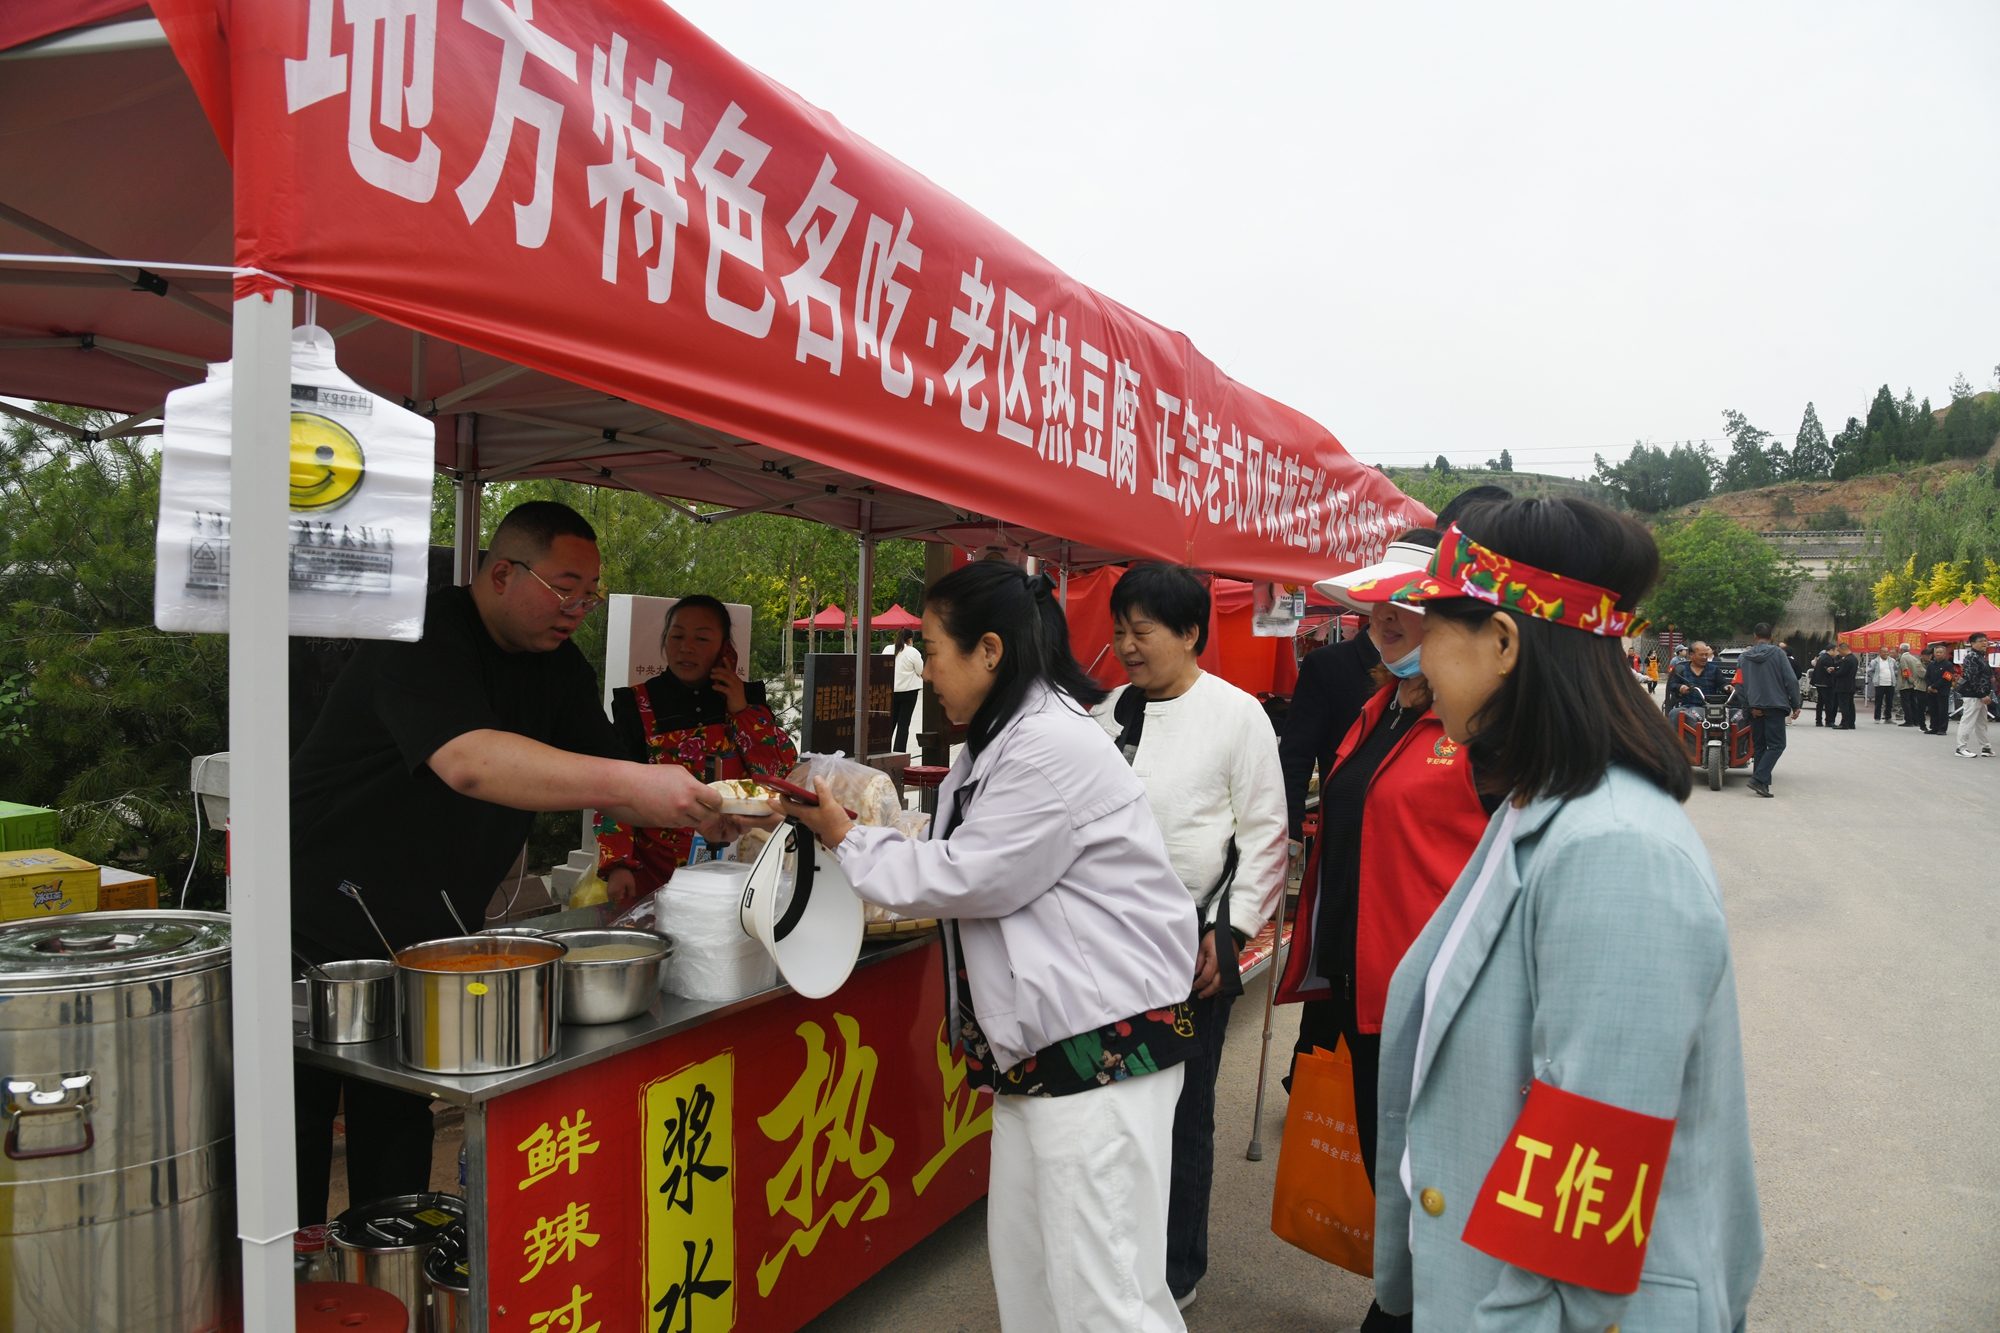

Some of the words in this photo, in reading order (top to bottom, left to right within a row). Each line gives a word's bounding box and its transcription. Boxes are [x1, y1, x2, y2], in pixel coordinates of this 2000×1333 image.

[1302, 1110, 1358, 1136] 深入开展法
[1310, 1137, 1364, 1165] 增强全民法
[653, 1083, 732, 1333] 浆水
